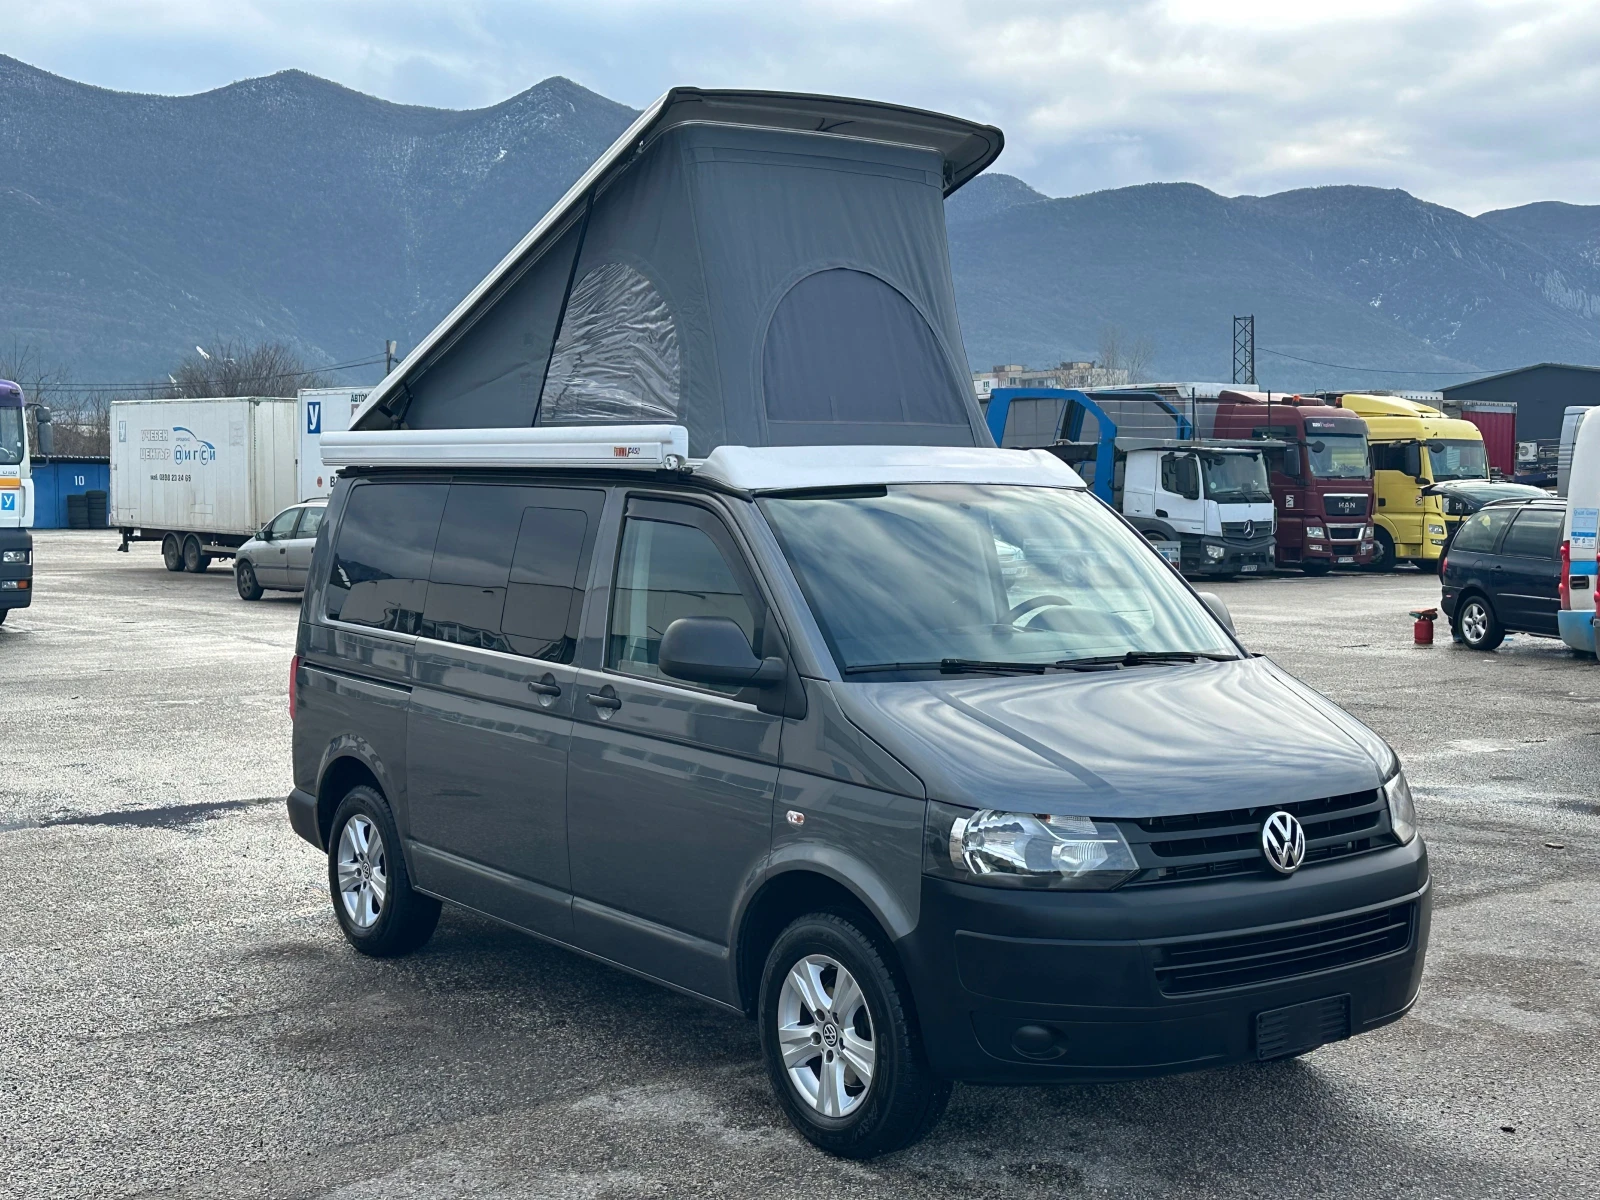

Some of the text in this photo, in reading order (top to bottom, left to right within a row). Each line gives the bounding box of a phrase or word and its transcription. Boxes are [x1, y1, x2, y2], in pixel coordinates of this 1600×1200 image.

[140, 429, 169, 442] УЧЕБЕН
[139, 447, 171, 461] ЦЕНТЪР
[74, 475, 85, 486] 10
